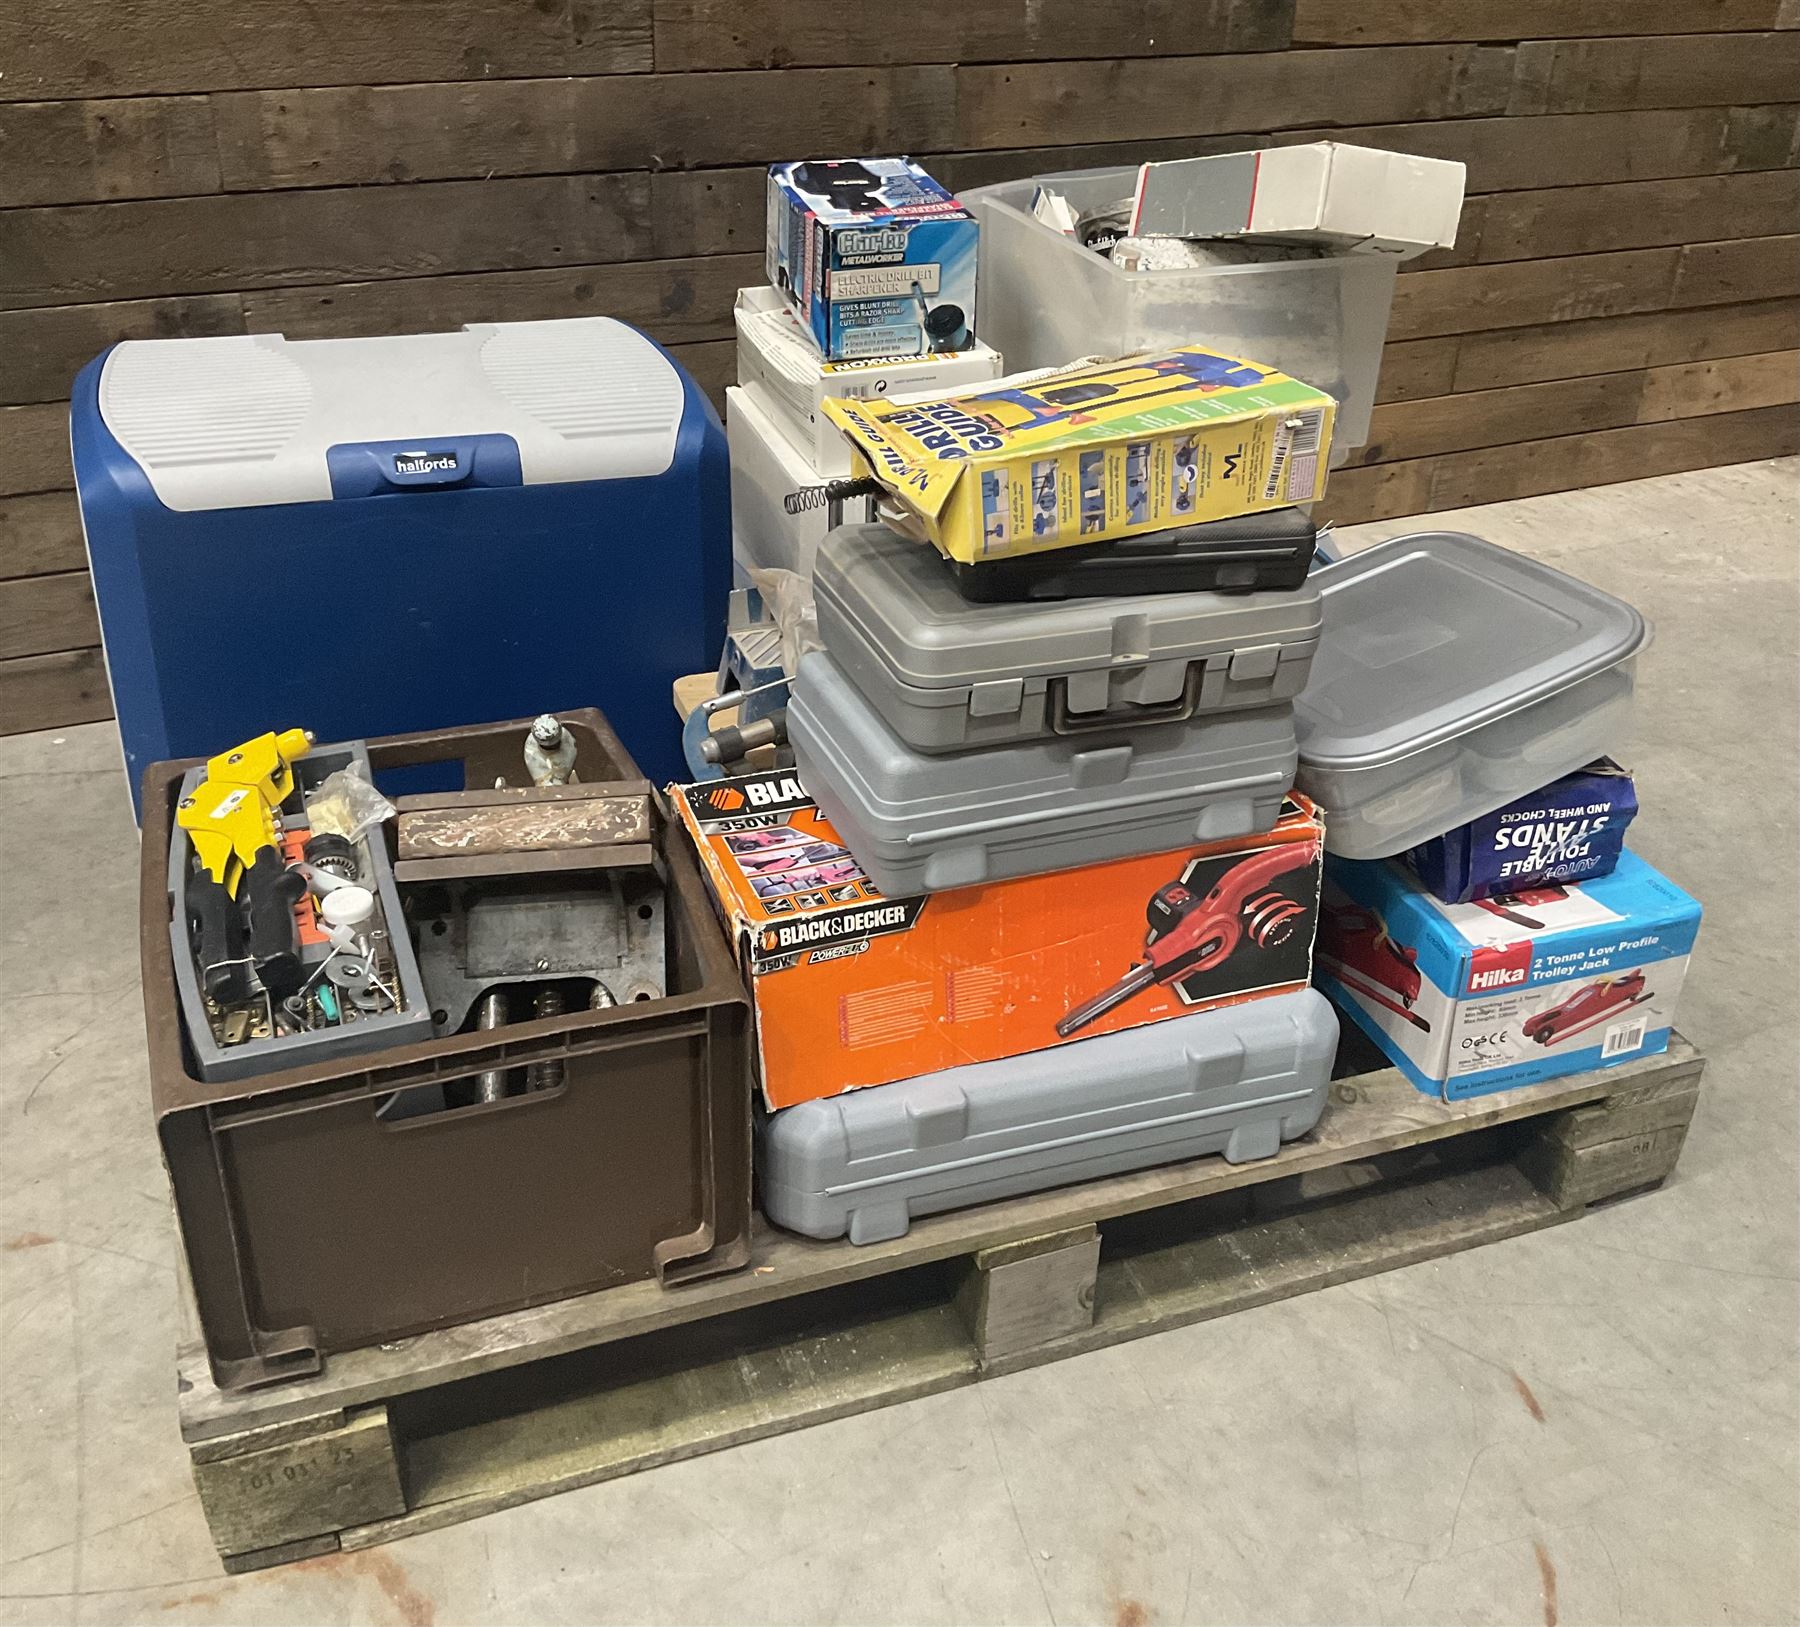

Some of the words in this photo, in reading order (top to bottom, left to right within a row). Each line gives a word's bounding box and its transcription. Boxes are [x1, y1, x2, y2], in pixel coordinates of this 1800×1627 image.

[838, 230, 907, 255] Clarke
[841, 253, 904, 266] METALWORKER
[838, 271, 884, 286] ELECTRIC
[887, 270, 915, 282] DRILL
[917, 269, 933, 280] BIT
[838, 282, 900, 297] SHARPENER
[840, 303, 859, 312] GIVES
[860, 301, 881, 310] BLUNT
[882, 300, 900, 308] DRILL
[840, 311, 854, 320] BITS
[861, 309, 882, 318] RAZOR
[883, 307, 905, 316] SHARP
[868, 316, 885, 325] EDGE
[834, 354, 929, 373] PROXXON
[842, 408, 885, 443] GUIDE
[914, 402, 1004, 451] GUIDE
[893, 413, 968, 460] DRILL
[396, 458, 457, 473] halfords
[1501, 809, 1546, 823] CHOCKS
[1548, 806, 1584, 819] WHEEL
[1587, 802, 1611, 815] AND
[718, 814, 779, 832] 350W
[1494, 816, 1610, 851] STANDS
[1534, 958, 1542, 968] 2
[1546, 951, 1585, 966] Tonne
[1588, 946, 1616, 958] Low
[1618, 935, 1660, 952] Profile
[1532, 965, 1576, 981] Trolley
[1579, 958, 1610, 971] Jack
[1471, 967, 1525, 990] Hilka
